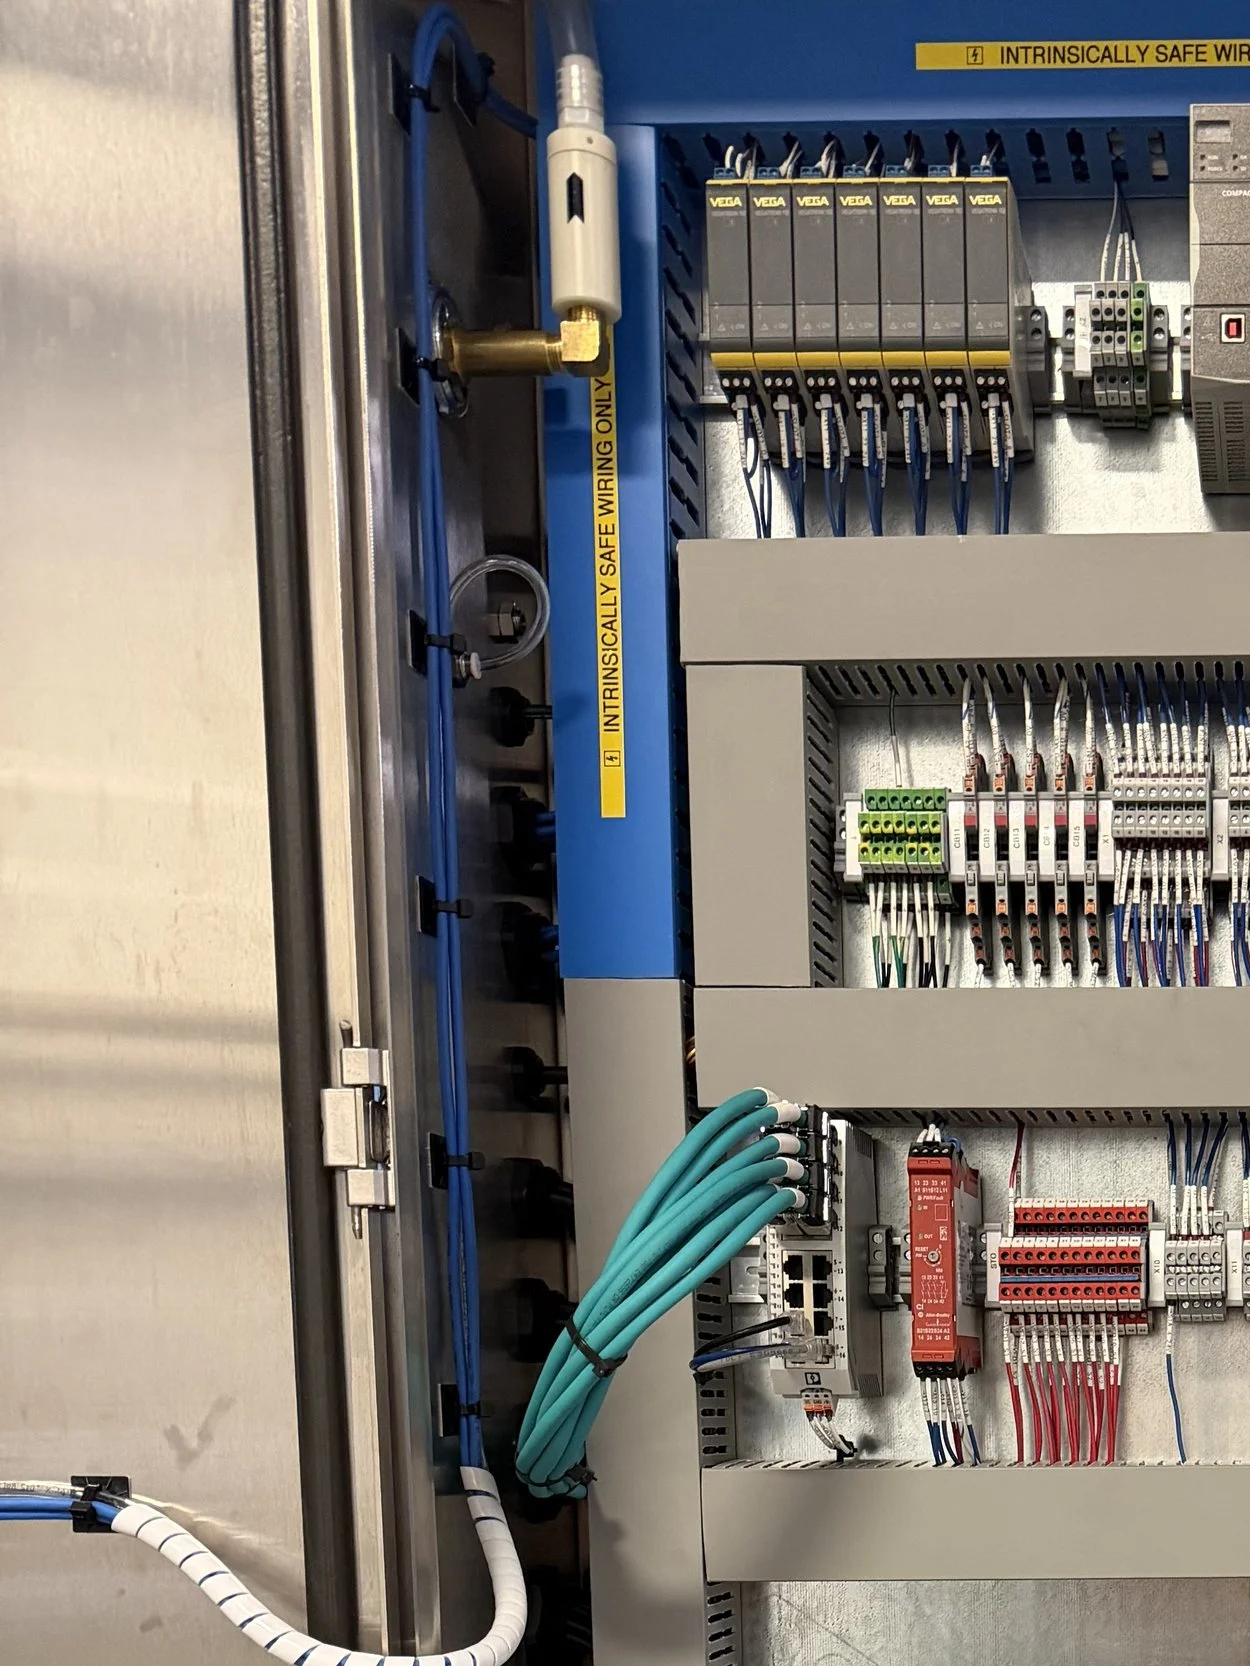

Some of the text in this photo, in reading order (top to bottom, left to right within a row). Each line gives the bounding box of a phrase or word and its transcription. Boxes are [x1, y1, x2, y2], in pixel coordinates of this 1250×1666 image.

[1000, 45, 1150, 65] INTRINSICALLY
[1155, 44, 1207, 63] SAFE
[710, 197, 742, 207] VEGA
[753, 197, 786, 207] VEGA
[796, 196, 829, 206] VEGA
[840, 196, 873, 206] VEGA
[883, 195, 916, 205] VEGA
[926, 195, 959, 205] VEGA
[969, 194, 1002, 205] VEGA
[594, 377, 620, 732] INTRINSICALLY SAFE WIRING ONLY
